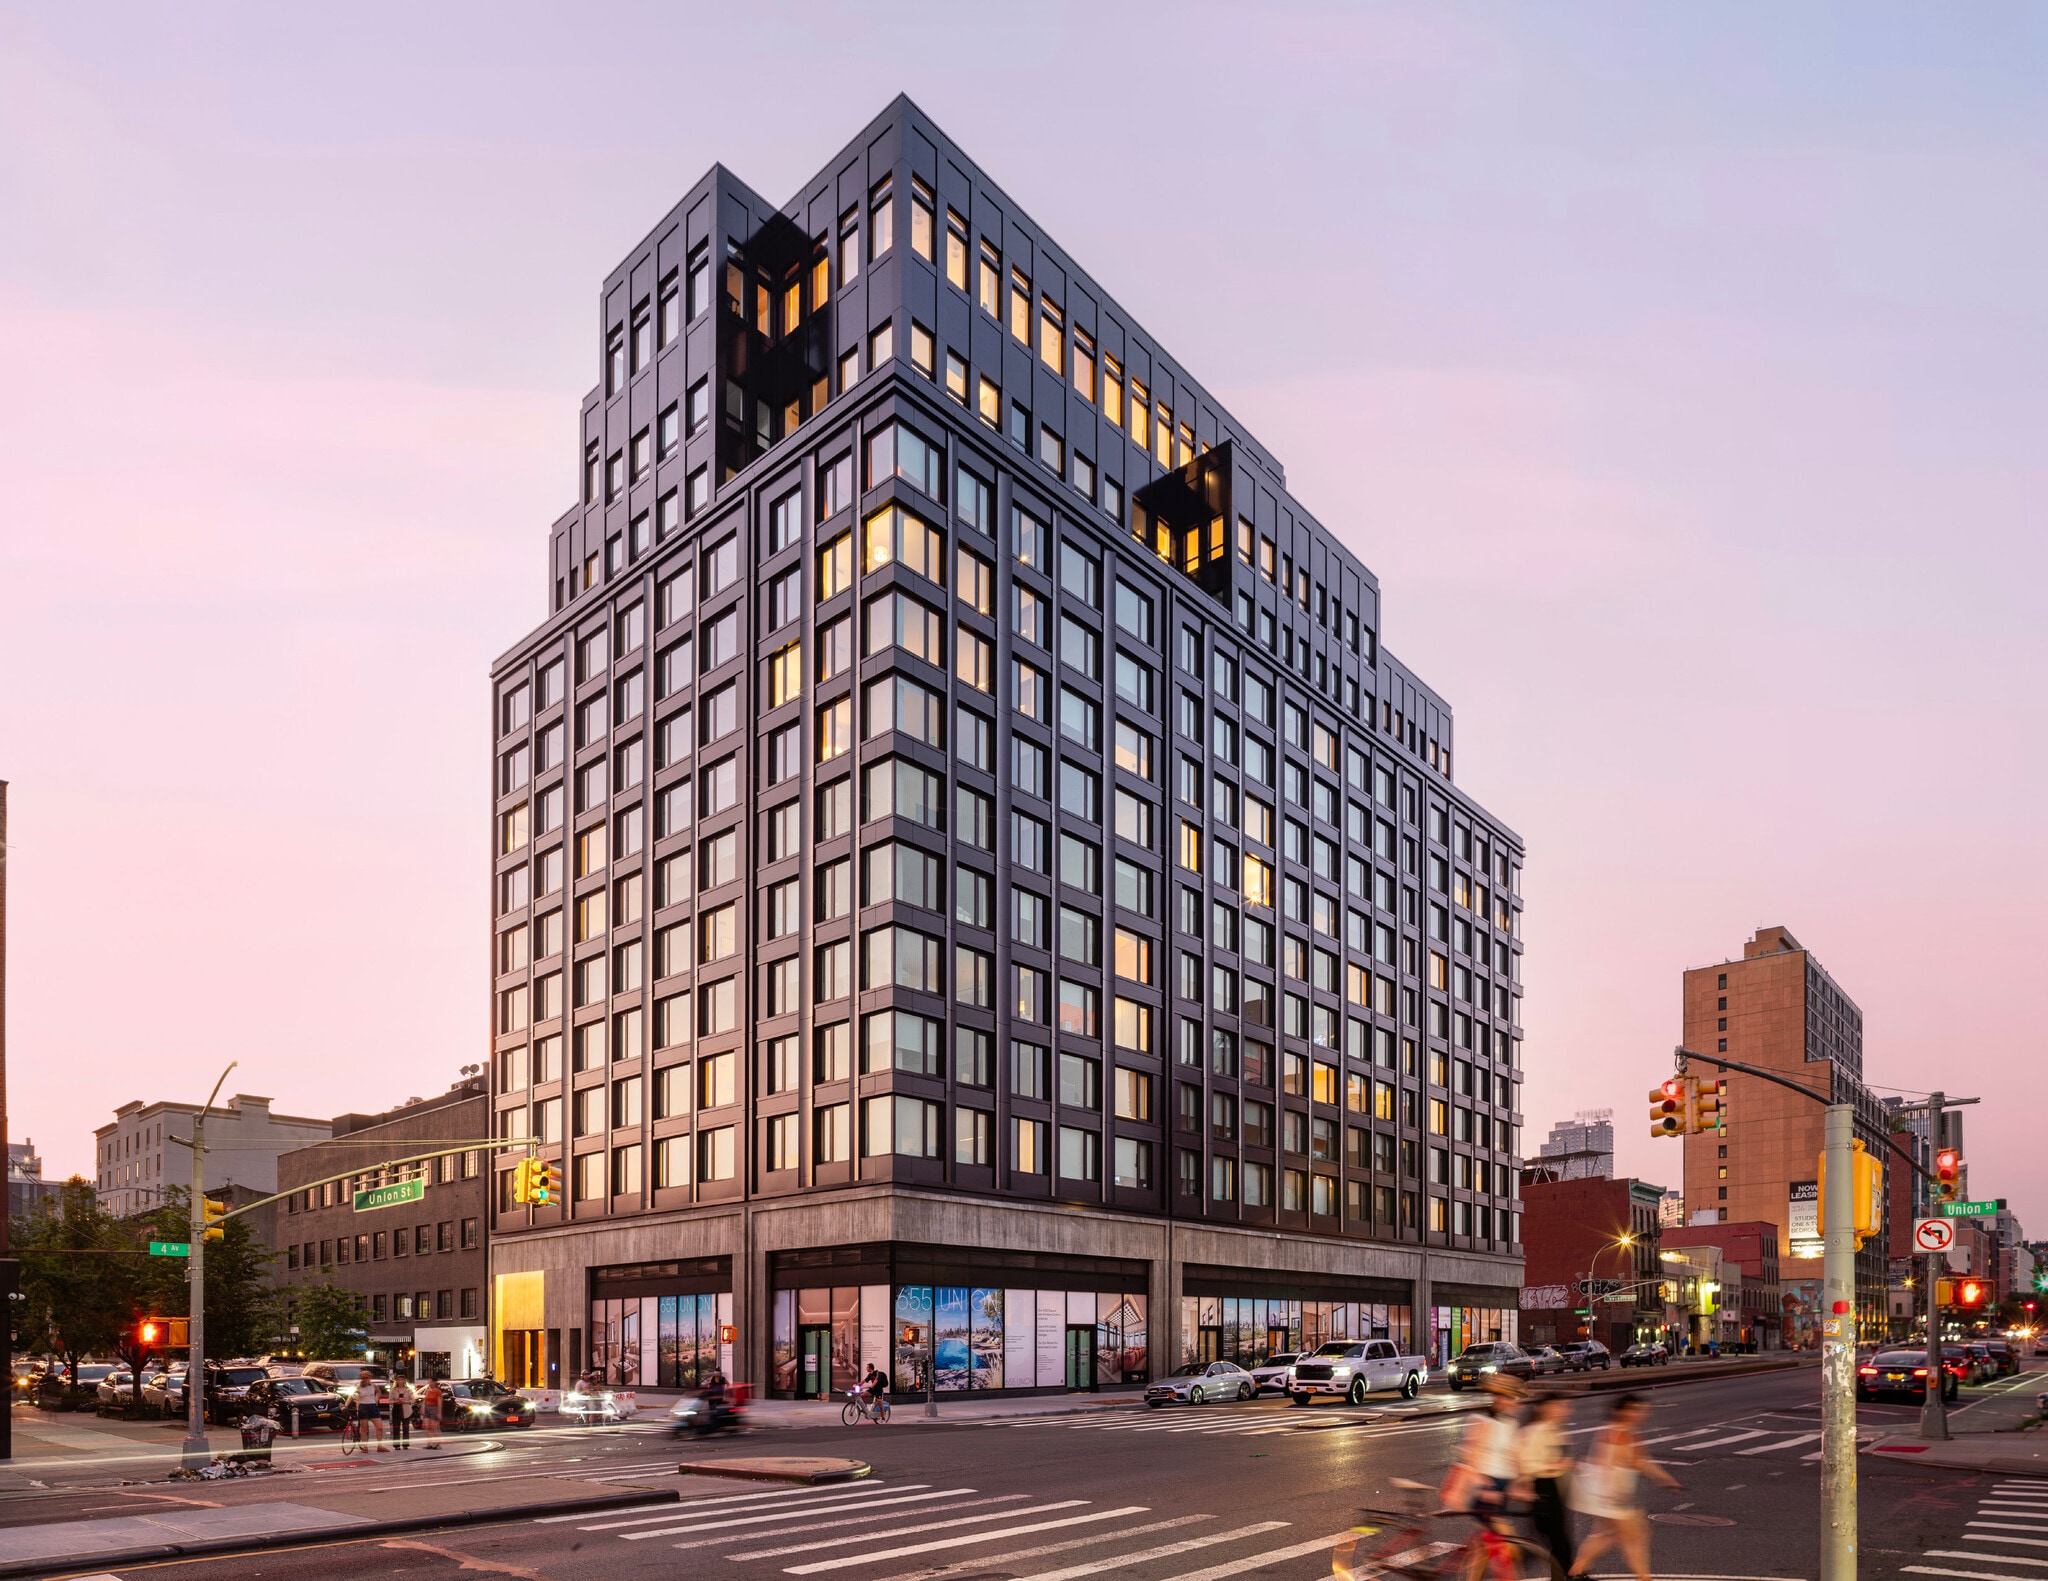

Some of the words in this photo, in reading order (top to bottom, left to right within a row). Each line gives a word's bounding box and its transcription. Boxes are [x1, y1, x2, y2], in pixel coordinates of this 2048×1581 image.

[368, 1191, 399, 1205] Union
[400, 1188, 411, 1198] St
[1948, 1204, 1981, 1215] Union
[1985, 1202, 1992, 1210] St
[160, 1244, 167, 1254] 4
[171, 1244, 180, 1252] Av
[661, 1297, 677, 1313] 655
[680, 1296, 711, 1312] UNION
[897, 1288, 933, 1311] 655
[940, 1288, 998, 1311] UNION
[1017, 1376, 1034, 1385] UNION
